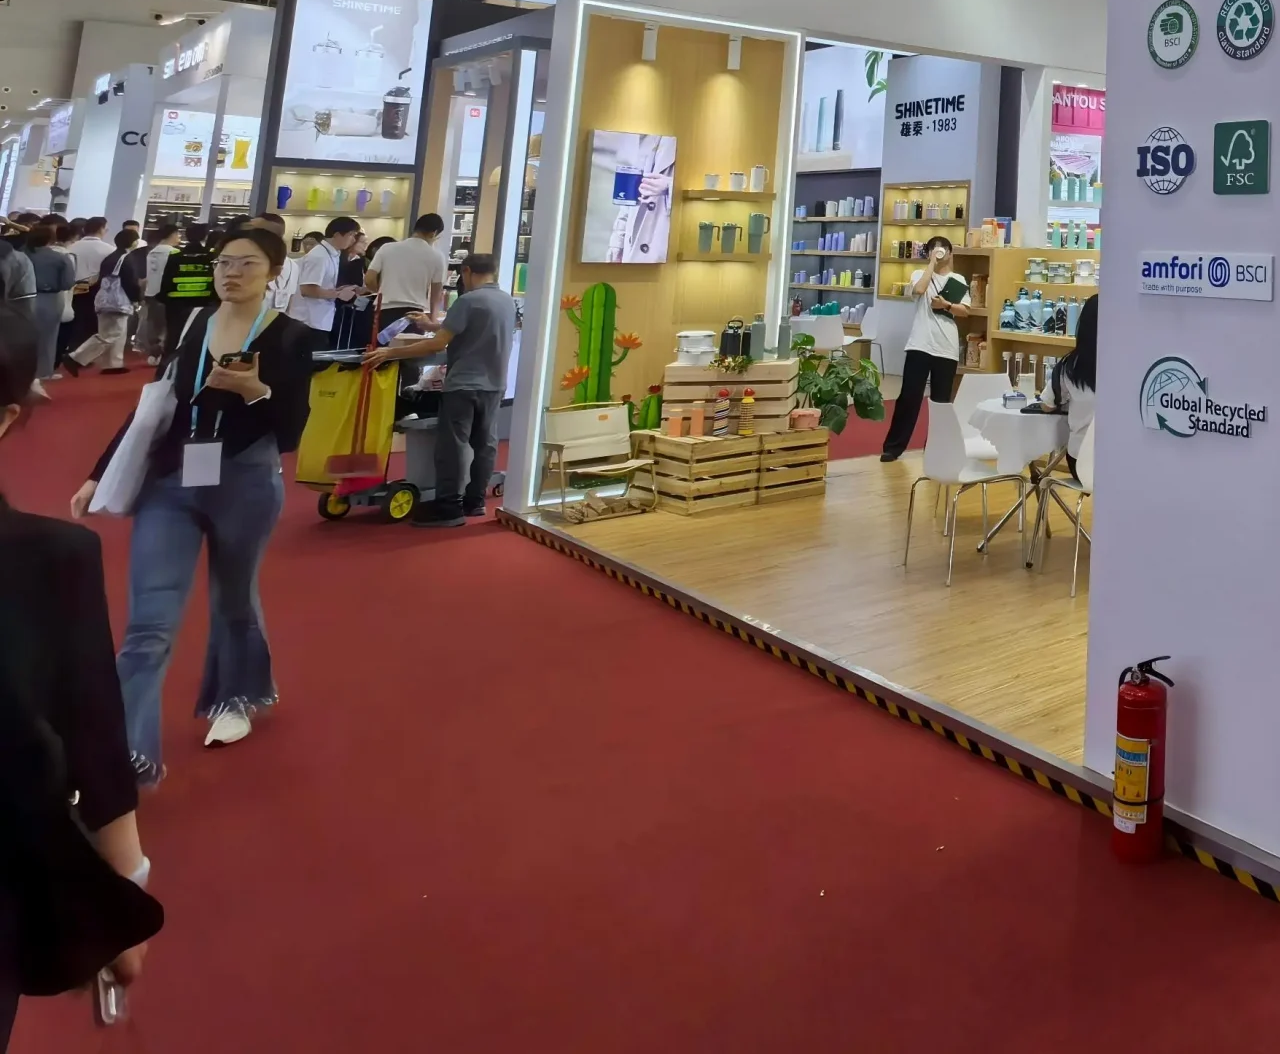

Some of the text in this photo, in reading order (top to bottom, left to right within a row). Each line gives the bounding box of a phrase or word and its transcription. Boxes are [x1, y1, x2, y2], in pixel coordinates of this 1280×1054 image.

[1164, 36, 1181, 47] BSCI
[1218, 26, 1270, 58] claim standard
[895, 94, 966, 120] SHINETIME
[1052, 91, 1098, 110] ANTOU
[932, 117, 957, 133] 1983
[1136, 143, 1195, 177] ISO
[1226, 172, 1255, 185] FSC
[1141, 256, 1267, 283] amfori BSCI
[1142, 282, 1203, 294] Trade with purpose
[1160, 392, 1266, 422] Global Recycled
[1188, 414, 1250, 438] Standard
